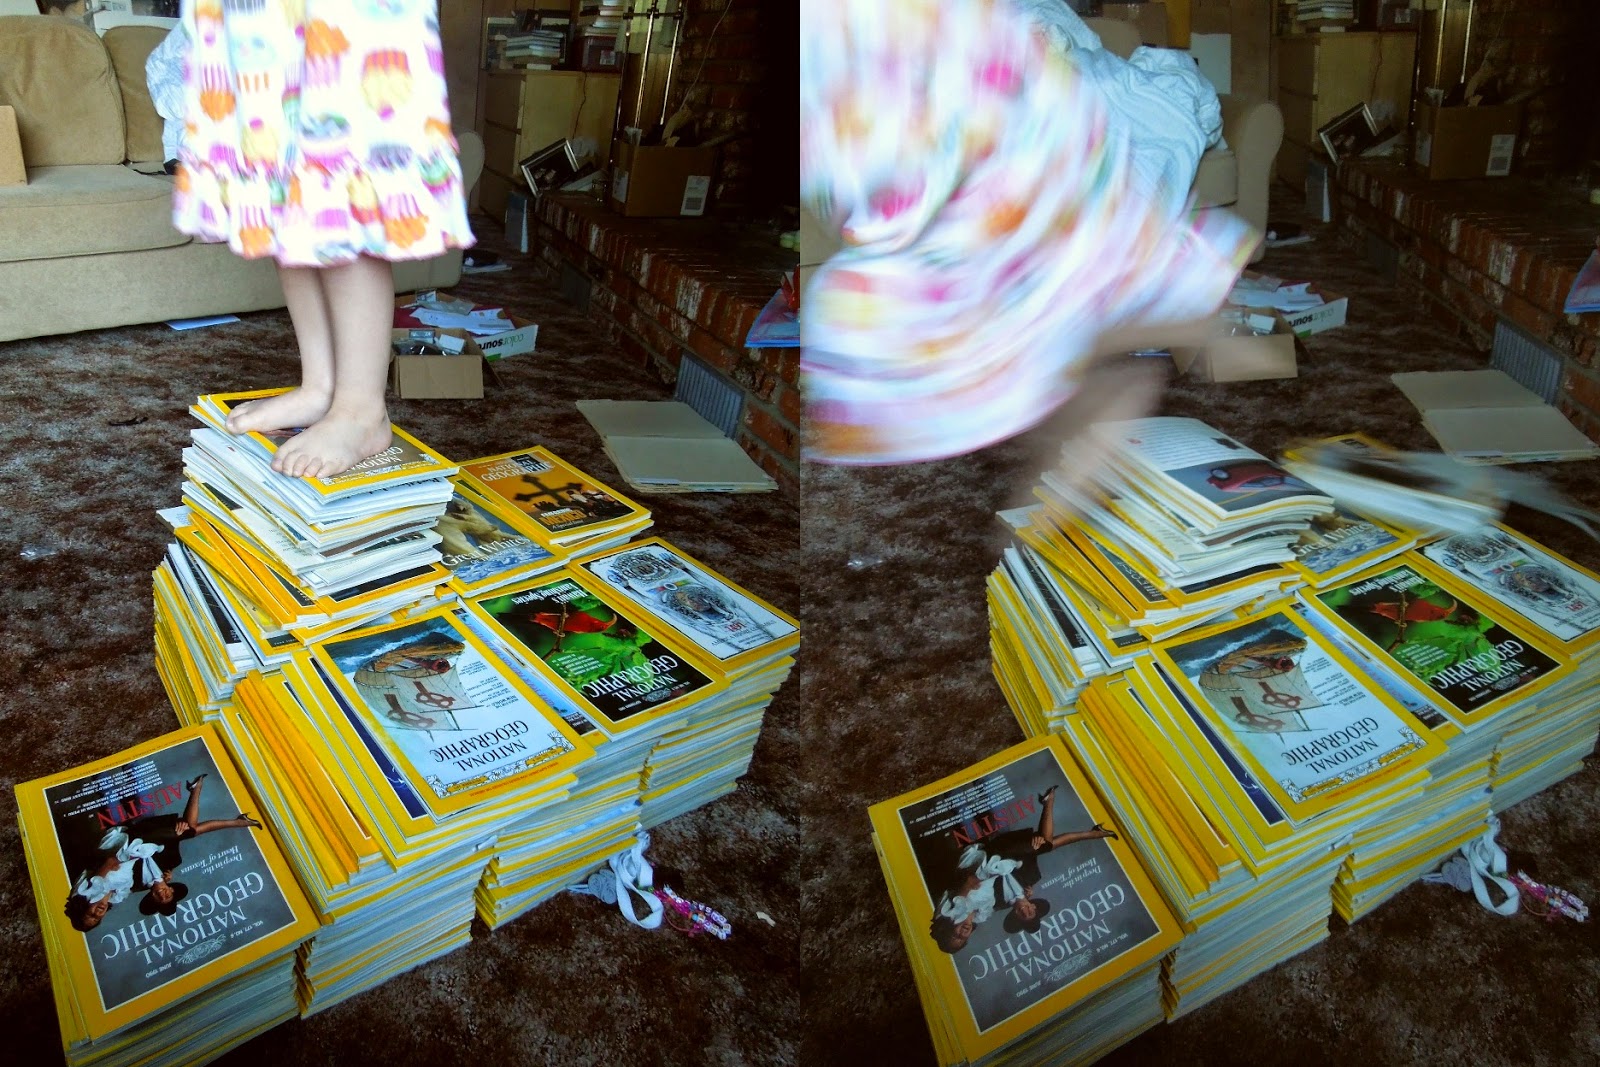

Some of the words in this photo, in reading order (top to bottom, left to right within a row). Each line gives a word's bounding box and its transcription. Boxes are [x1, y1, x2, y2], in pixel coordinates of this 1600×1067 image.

[347, 456, 402, 471] NATION
[441, 551, 481, 566] Great
[1374, 568, 1413, 586] Vanishing
[1389, 576, 1425, 592] Hawaii's
[537, 582, 577, 598] Vanishing
[1348, 580, 1381, 596] Species
[510, 591, 543, 606] Species
[551, 589, 587, 604] Hawaii's
[1429, 639, 1524, 688] GEOGRAPHIC
[581, 654, 678, 697] GEOGRAPHIC
[1461, 658, 1523, 692] NATIONAL
[612, 673, 675, 701] NATIONAL
[429, 718, 528, 764] GEOGRAPHIC
[1281, 717, 1379, 766] GEOGRAPHIC
[453, 738, 525, 773] NATIONAL
[1306, 737, 1377, 775] NATIONAL
[93, 782, 186, 828] AUSTIN
[949, 795, 1040, 846] AUSTIN
[207, 853, 217, 862] of
[217, 845, 238, 858] Heart
[222, 852, 242, 866] Deep
[180, 859, 207, 874] Texans
[201, 865, 215, 875] the
[1065, 866, 1075, 876] of
[1075, 857, 1096, 871] Heart
[1081, 864, 1101, 878] Deep
[1040, 873, 1066, 889] Texans
[1061, 879, 1075, 890] the
[99, 871, 265, 957] GEOGRAPHIC
[136, 906, 245, 965] NATIONAL
[967, 883, 1126, 978] GEOGRAPHIC
[1005, 919, 1110, 984] NATIONAL
[145, 968, 158, 977] 1990
[158, 962, 172, 971] JUNE
